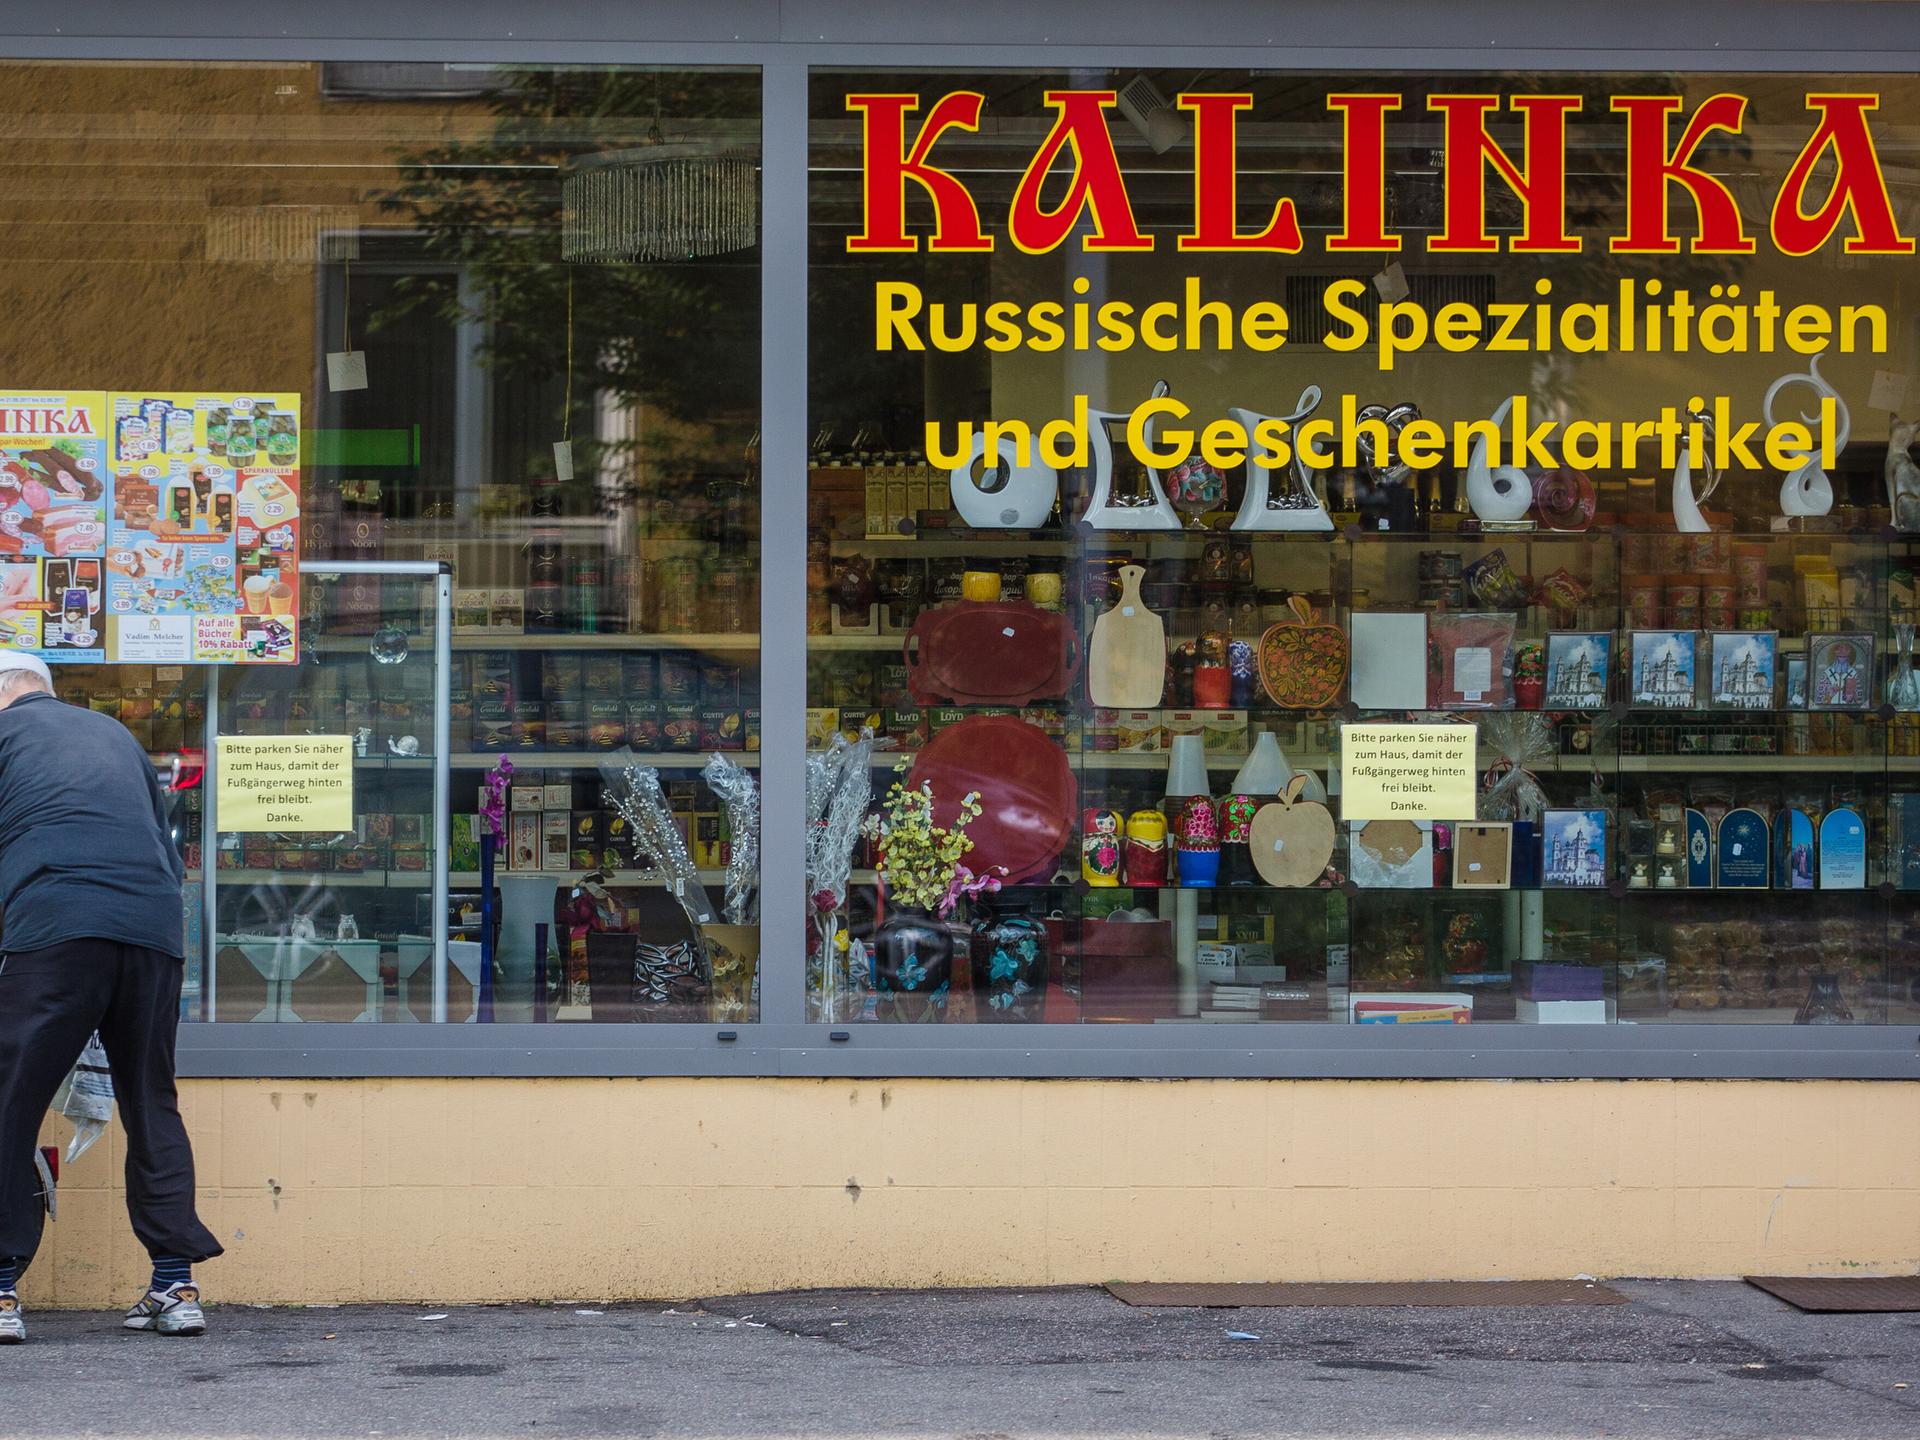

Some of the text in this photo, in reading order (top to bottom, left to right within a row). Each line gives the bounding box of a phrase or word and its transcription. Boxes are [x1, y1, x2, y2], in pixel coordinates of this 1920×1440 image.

[845, 90, 1916, 256] KALINKA
[876, 277, 1887, 371] Russische Spezialitäten
[925, 394, 1836, 471] und Geschenkartikel
[198, 618, 235, 628] Auf alle
[198, 628, 232, 638] Bücher
[198, 640, 253, 649] 10% Rabatt
[592, 704, 618, 713] Greenfield
[667, 704, 693, 713] Greenfield
[843, 711, 866, 719] CURTIS
[895, 711, 919, 722] LOYD
[940, 711, 964, 721] LOYD
[1351, 733, 1468, 744] Bitte parken Sie näher
[226, 744, 344, 756] Bitte parken Sie näher
[1355, 750, 1463, 761] zum Haus, damit der
[230, 761, 340, 772] zum Haus, damit der
[1352, 766, 1466, 778] Fußgängerweg hinten
[227, 778, 342, 789] Fußgängerweg hinten
[1381, 783, 1436, 793] frei bleibt.
[257, 794, 312, 804] frei bleibt.
[1390, 801, 1427, 811] Danke.
[266, 812, 304, 823] Danke.
